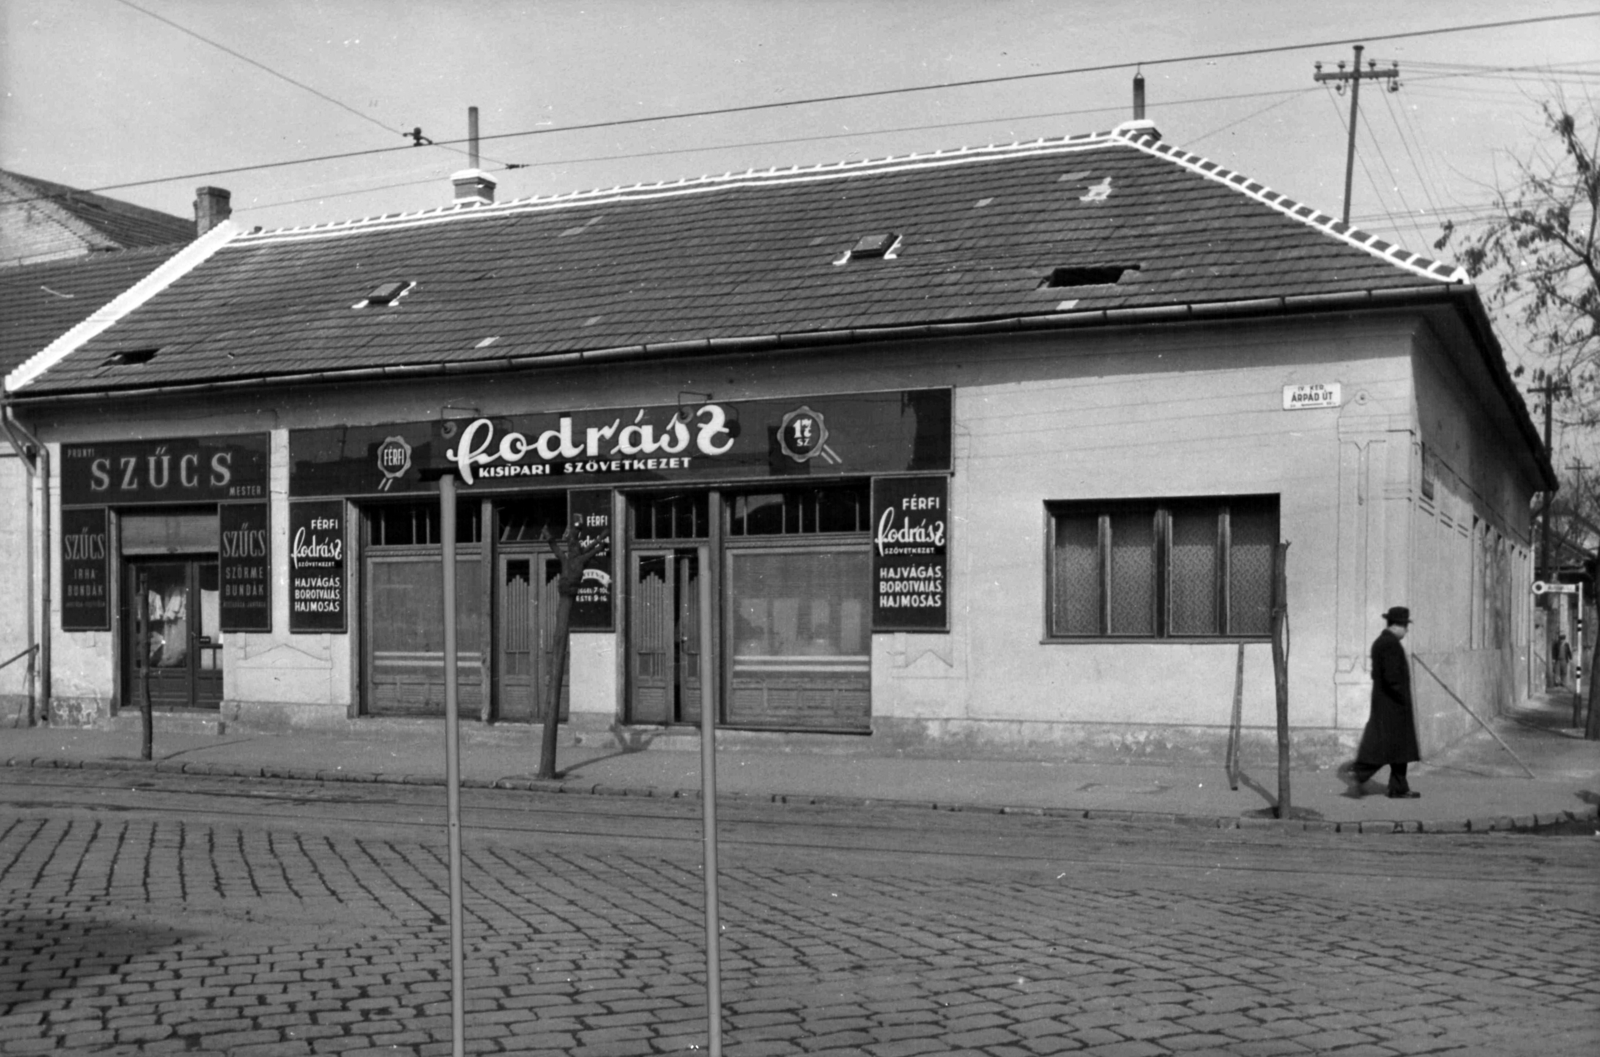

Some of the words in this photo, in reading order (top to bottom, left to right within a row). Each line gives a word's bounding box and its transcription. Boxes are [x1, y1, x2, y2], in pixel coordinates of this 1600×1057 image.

[1291, 390, 1320, 402] ÁRPÁD
[1322, 389, 1333, 400] ÚT
[792, 418, 813, 438] 17
[383, 445, 405, 466] FÉRFI
[90, 446, 232, 491] SZŰCS
[564, 457, 692, 474] SZÖVETKEZET
[229, 485, 262, 497] MESTER
[902, 493, 940, 511] FÉRFI
[311, 516, 338, 530] FÉRFI
[586, 513, 608, 527] FÉRFI
[874, 506, 945, 557] fodrász
[64, 526, 105, 561] SZŰCS
[223, 522, 266, 558] SZŰCS
[291, 526, 342, 570] fodrász
[884, 546, 935, 555] SZÖVETKEZET
[298, 560, 335, 568] SZÖVETKEZET
[67, 582, 103, 597] BUNDÁK
[225, 581, 264, 597] BUNDÁK
[294, 599, 340, 612] HAJMOSÁS
[879, 592, 941, 608] HAJMOSÁS
